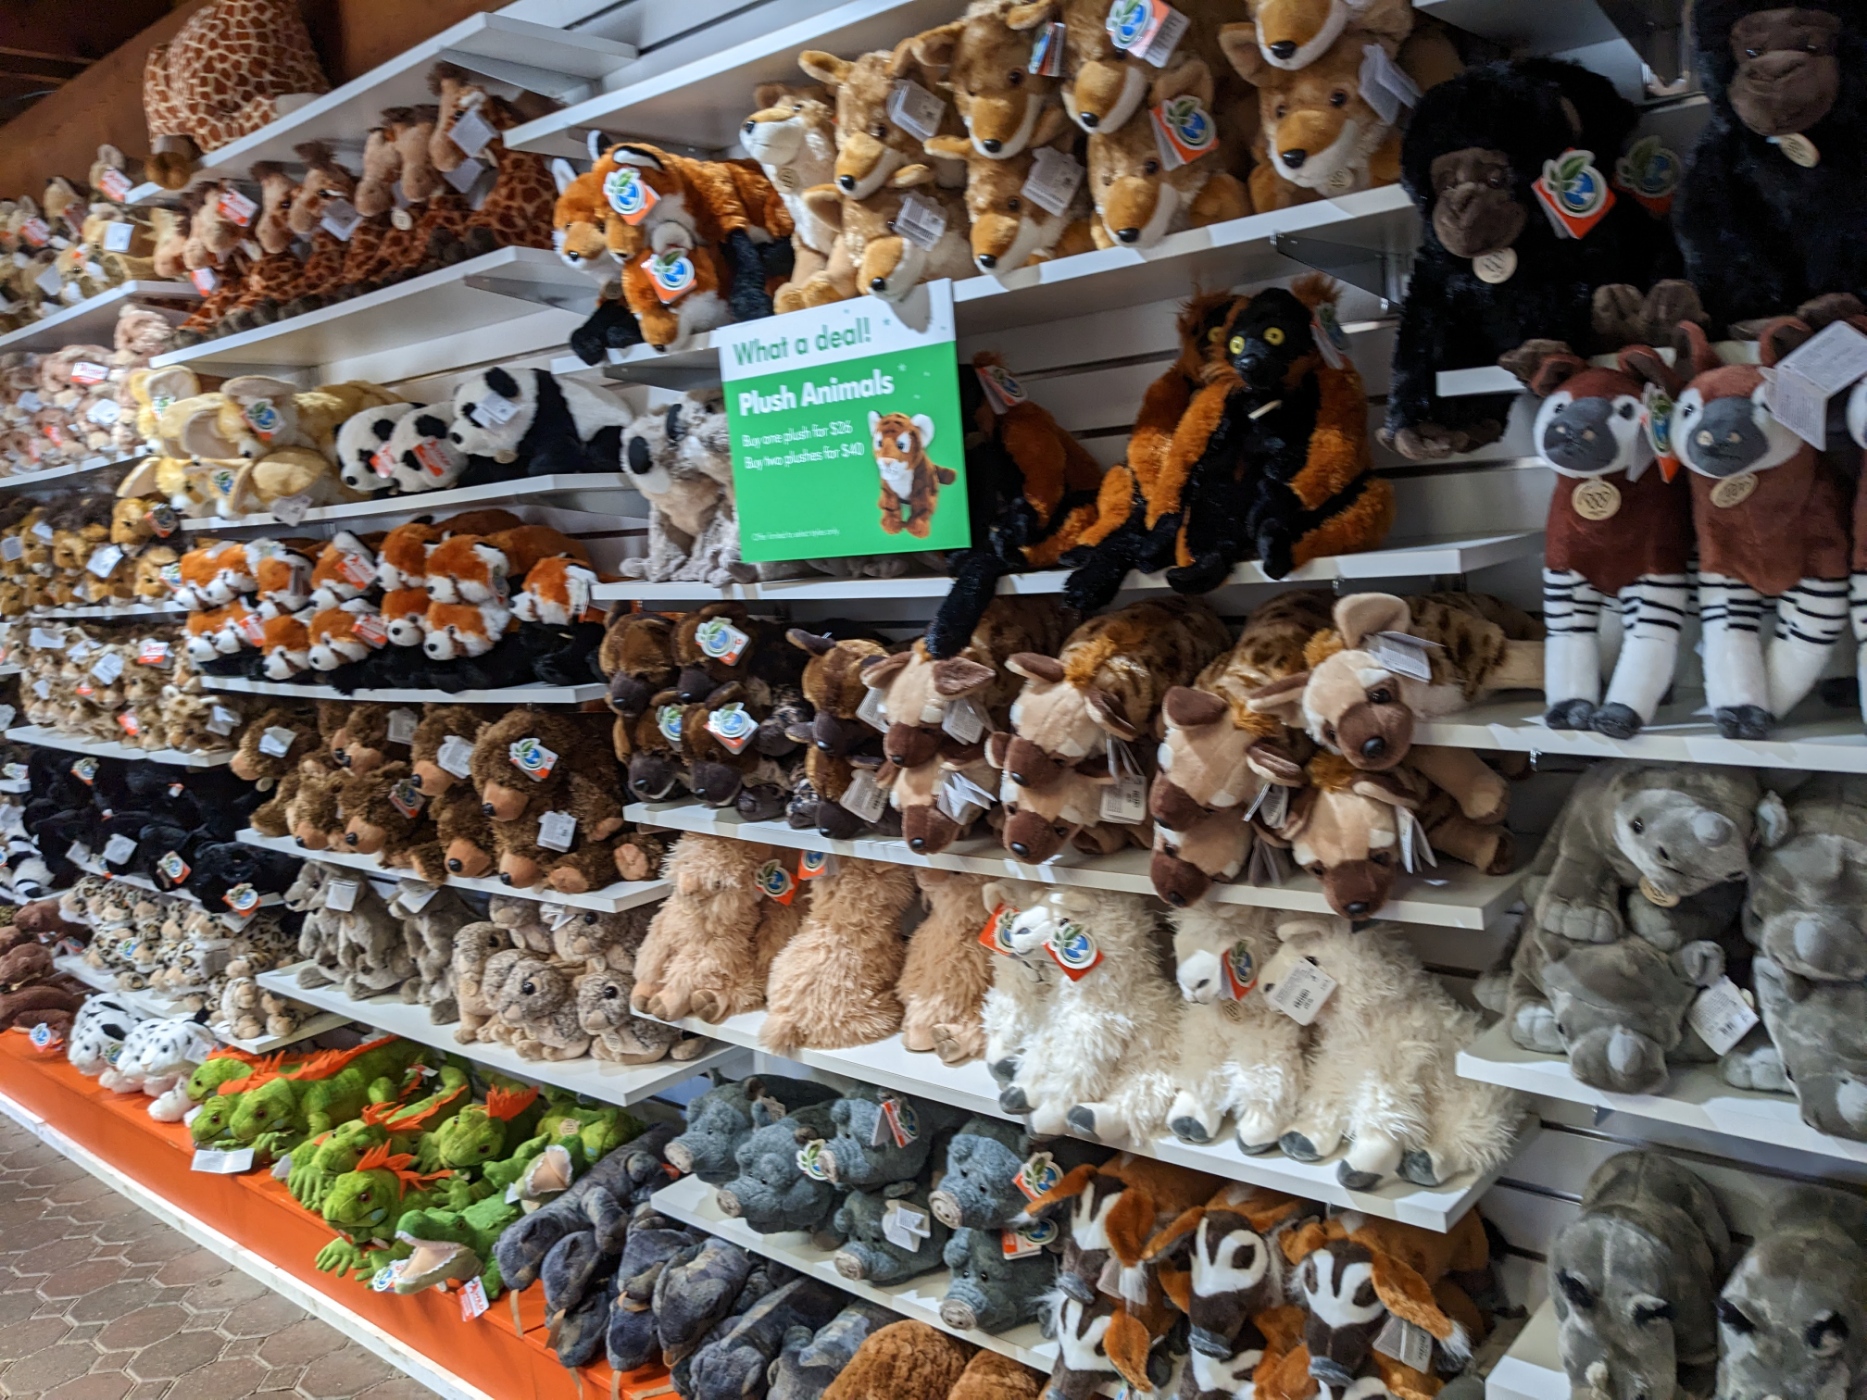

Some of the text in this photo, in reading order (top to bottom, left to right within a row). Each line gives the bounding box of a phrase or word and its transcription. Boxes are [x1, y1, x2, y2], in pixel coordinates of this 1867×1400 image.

[733, 317, 872, 365] What a deal!
[738, 368, 895, 417] Plush Animals
[742, 434, 761, 448] Buy
[762, 434, 783, 444] one
[783, 426, 812, 445] plush
[812, 424, 828, 437] for
[744, 456, 763, 471] Buy
[763, 455, 783, 467] two
[784, 450, 823, 468] plushes
[823, 445, 840, 459] for
